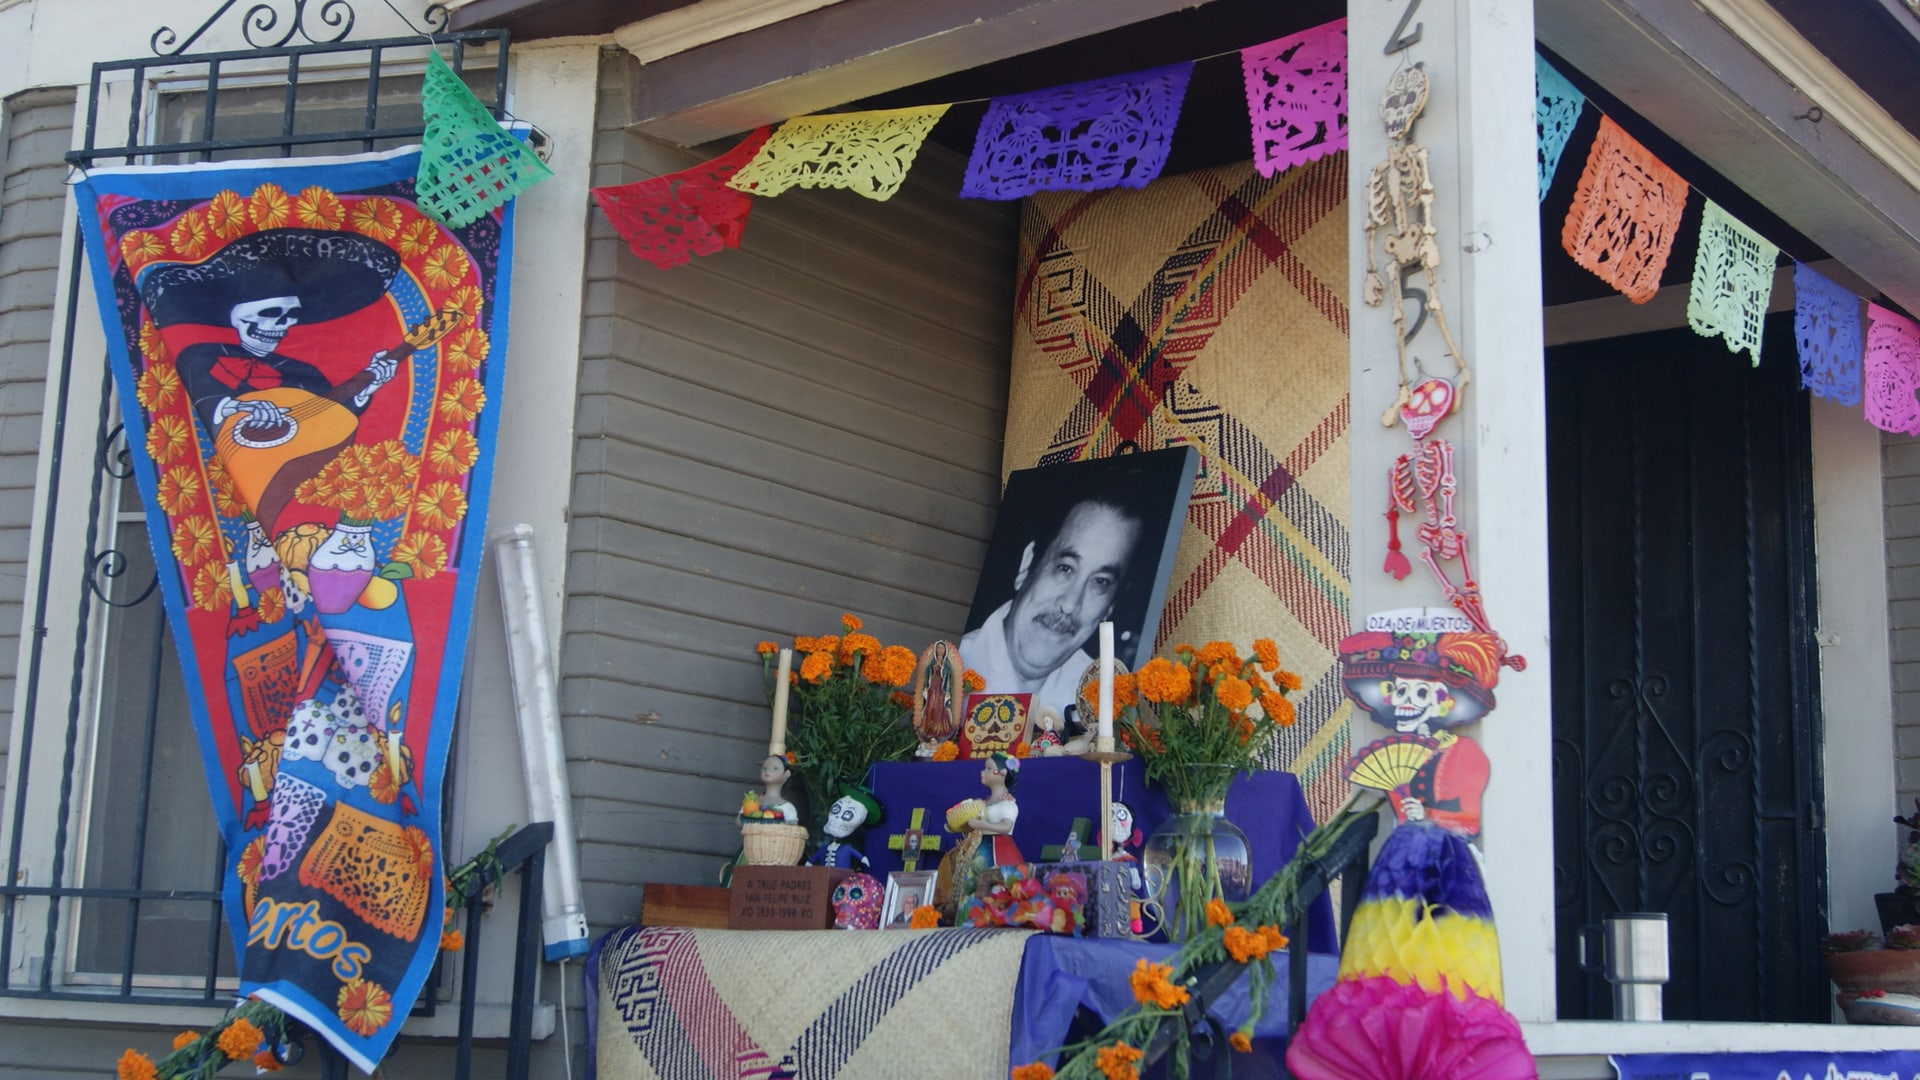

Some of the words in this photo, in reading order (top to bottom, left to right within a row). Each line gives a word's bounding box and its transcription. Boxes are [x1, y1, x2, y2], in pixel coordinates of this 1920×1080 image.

[1399, 258, 1429, 347] 5
[1369, 616, 1392, 629] DIA
[1397, 617, 1413, 631] DE
[747, 880, 753, 889] A
[757, 879, 777, 890] TRUE
[780, 880, 811, 891] PADRES
[741, 907, 754, 917] XO
[801, 908, 813, 919] XO
